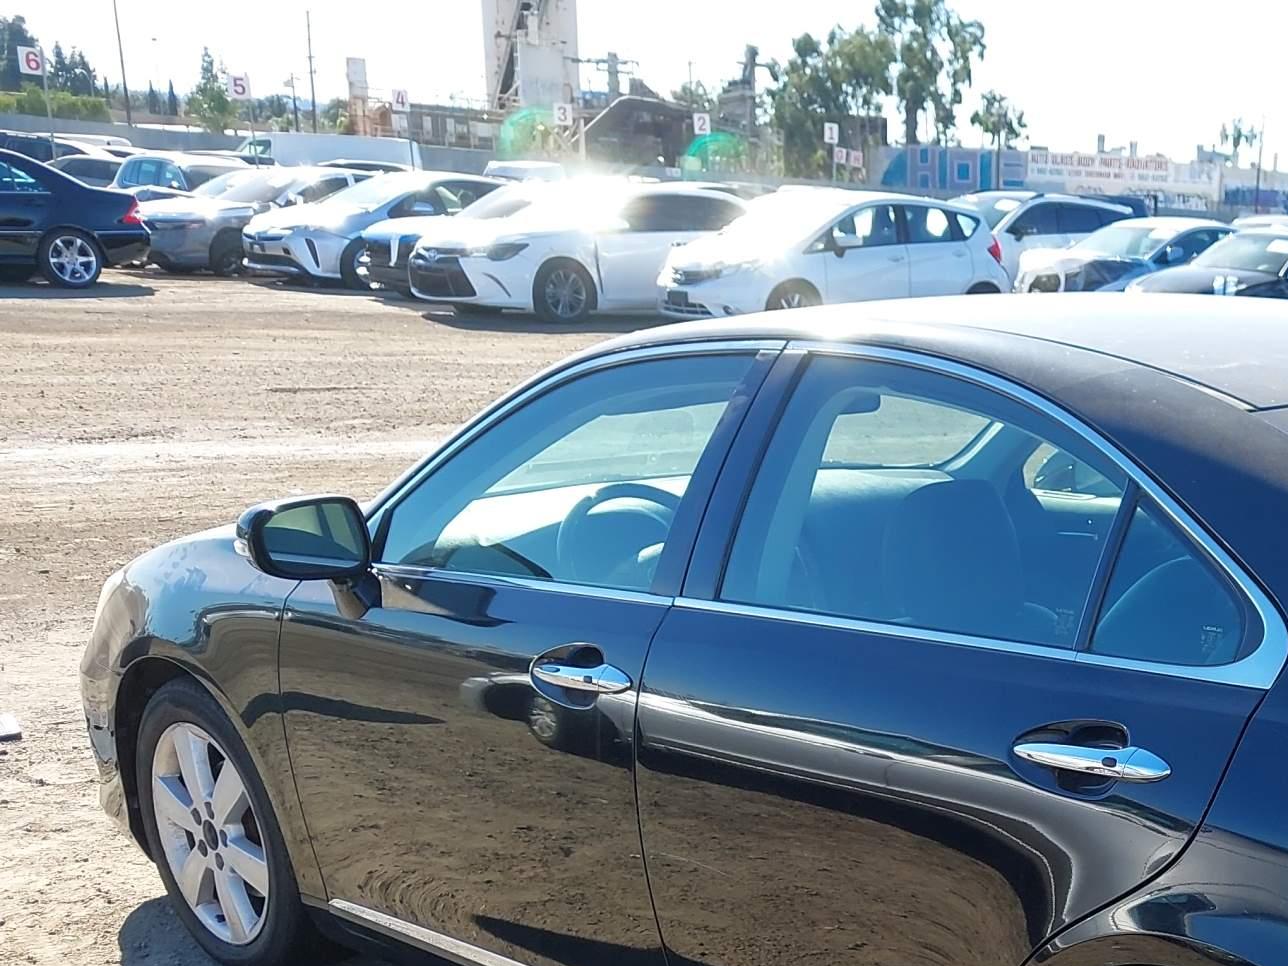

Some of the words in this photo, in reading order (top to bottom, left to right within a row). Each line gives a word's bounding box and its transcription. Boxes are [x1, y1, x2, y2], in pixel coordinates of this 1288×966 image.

[25, 51, 41, 71] 6
[233, 78, 246, 95] 5
[395, 90, 406, 107] 4
[557, 106, 568, 122] 3
[697, 116, 707, 131] 2
[828, 127, 836, 140] 1
